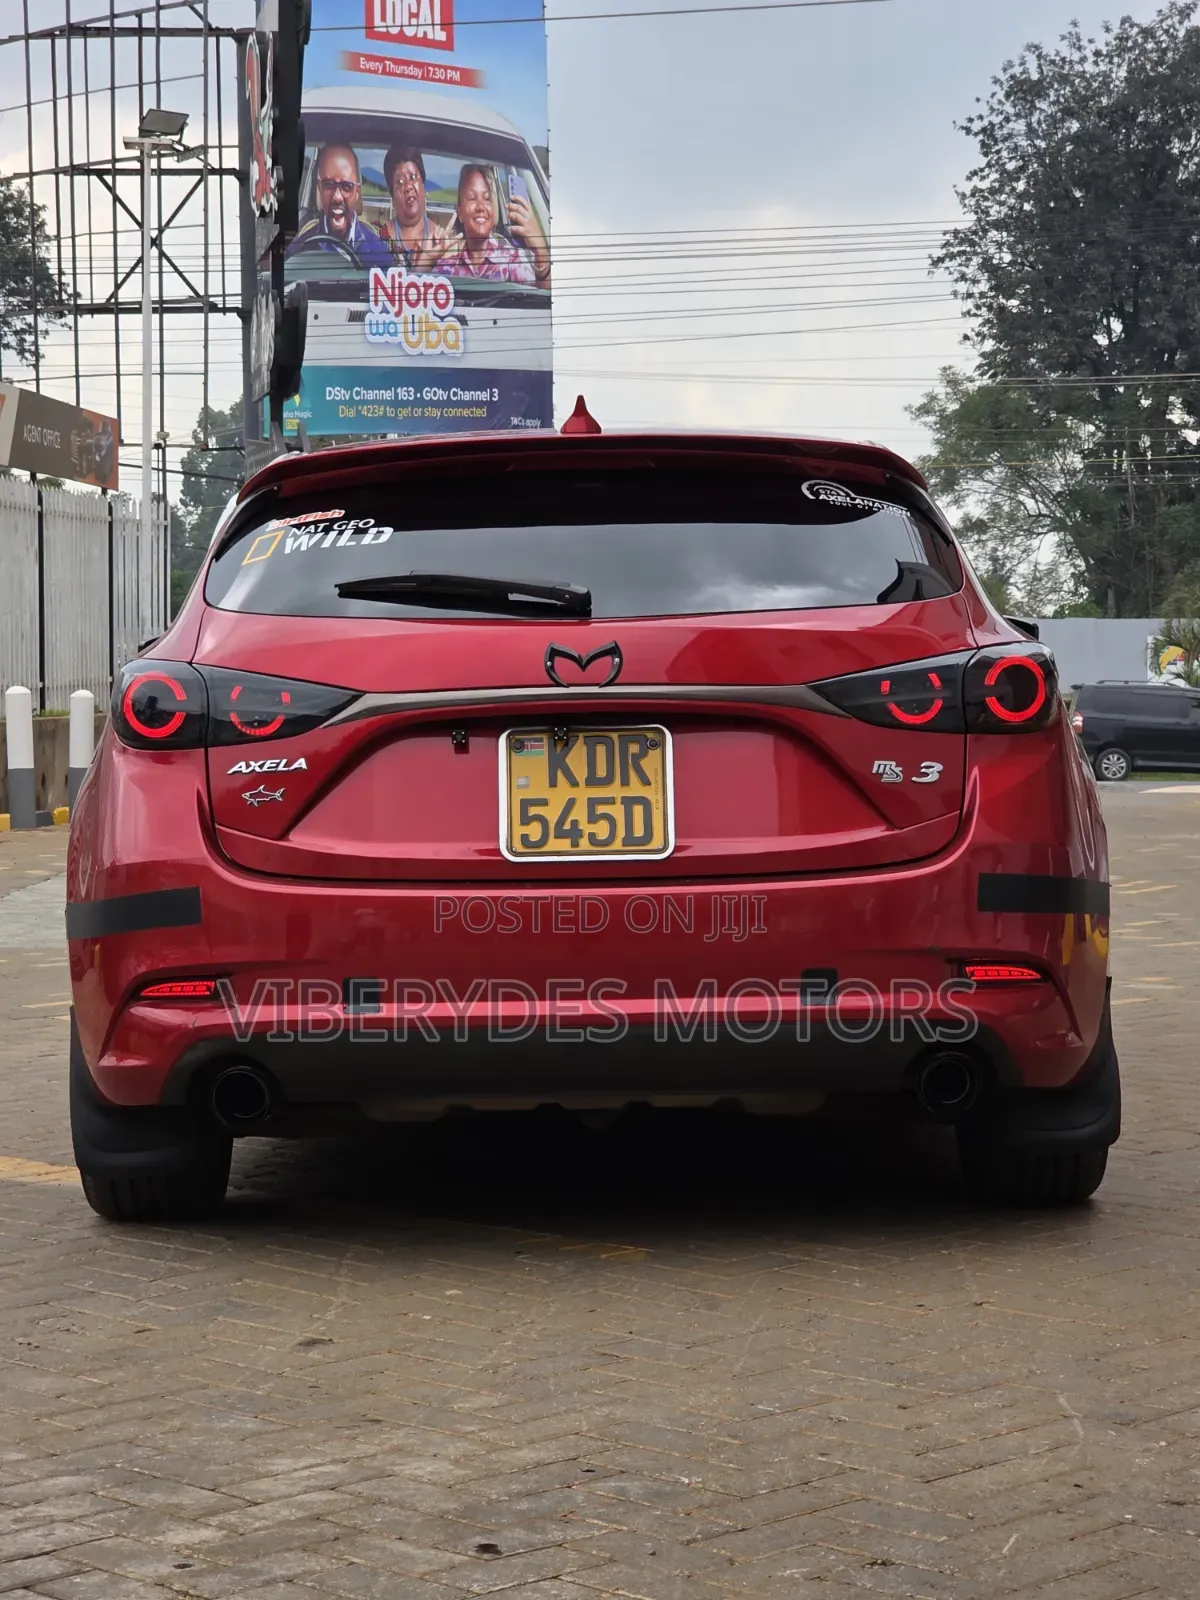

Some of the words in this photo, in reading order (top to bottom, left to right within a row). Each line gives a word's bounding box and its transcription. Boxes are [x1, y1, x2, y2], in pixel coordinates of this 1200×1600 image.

[373, 0, 447, 41] LOCAL
[359, 57, 383, 73] Every
[385, 60, 422, 79] Thursday
[428, 66, 446, 80] 7.30
[447, 69, 461, 82] PM
[373, 271, 451, 318] Njoro
[369, 319, 398, 337] wa
[403, 312, 461, 351] Uba
[325, 386, 351, 401] DStv
[352, 386, 395, 401] Channel
[396, 387, 415, 401] 163
[422, 387, 449, 401] GOtv
[450, 387, 490, 401] Channel
[491, 388, 499, 402] 3
[338, 405, 356, 418] Dial
[386, 406, 396, 417] to
[397, 406, 412, 420] get
[413, 408, 423, 417] or
[423, 406, 442, 420] stay
[443, 406, 487, 418] connected
[23, 424, 42, 445] AGENT
[42, 428, 61, 449] OFFICE
[284, 526, 394, 554] WILD
[288, 522, 329, 537] NAT
[332, 518, 376, 531] GEO
[226, 757, 308, 775] AXELA
[548, 734, 652, 788] KDR
[911, 761, 944, 783] 3
[519, 795, 654, 848] 545D
